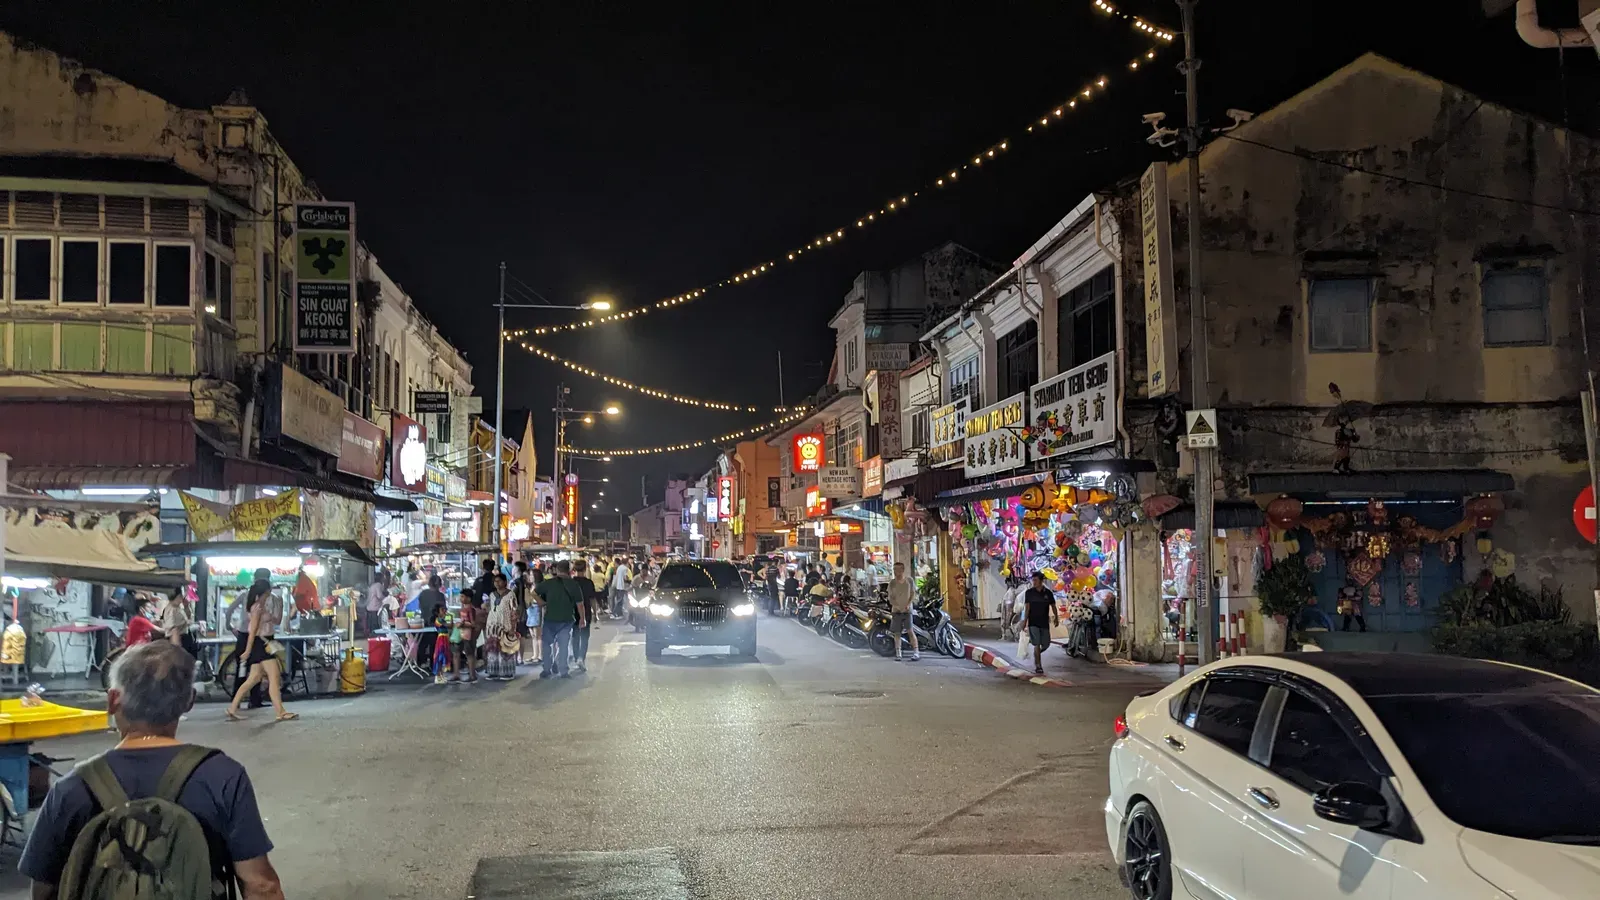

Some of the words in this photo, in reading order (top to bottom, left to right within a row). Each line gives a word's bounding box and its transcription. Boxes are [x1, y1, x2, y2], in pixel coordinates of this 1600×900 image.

[301, 209, 346, 223] Carlsberg
[300, 298, 318, 311] SIN
[321, 298, 348, 312] GUAT
[305, 312, 344, 326] KEONG
[1034, 379, 1066, 409] SYARIKAT
[1067, 371, 1085, 397] TEIK
[1085, 362, 1108, 389] SENG
[1004, 401, 1021, 425] SENG
[797, 436, 821, 447] HAPPY
